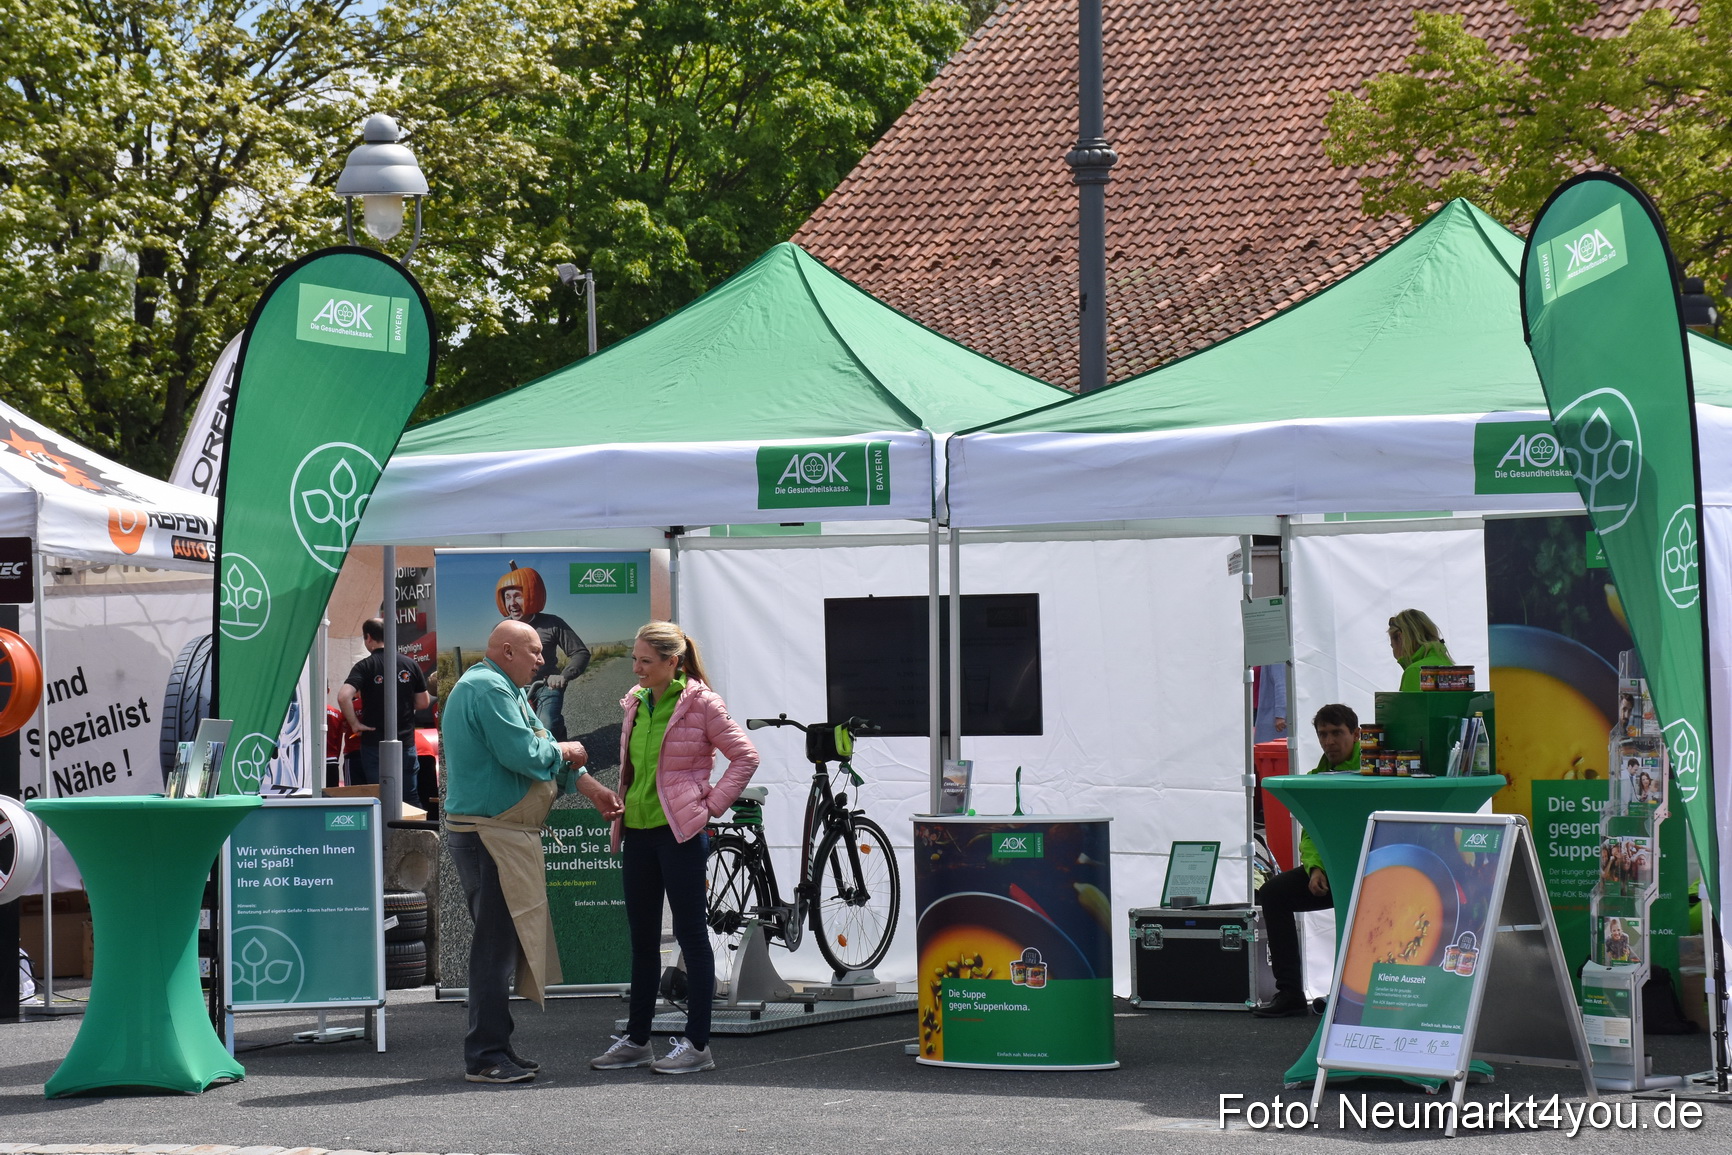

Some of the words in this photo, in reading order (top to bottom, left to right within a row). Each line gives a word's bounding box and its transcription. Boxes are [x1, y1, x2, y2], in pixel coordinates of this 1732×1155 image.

[313, 298, 373, 330] AOK
[394, 307, 404, 341] BAYERN
[310, 322, 320, 331] Die
[320, 324, 374, 339] Gesundheitskasse.
[776, 451, 849, 485] AOK
[874, 449, 884, 491] BAYERN
[1494, 470, 1508, 479] Die
[775, 486, 786, 495] Die
[787, 485, 851, 494] Gesundheitskasse.
[147, 510, 209, 536] REIFEN
[173, 539, 208, 561] AUTO
[0, 562, 24, 576] EC
[579, 568, 616, 583] AOK
[52, 760, 117, 798] Nähe
[1548, 797, 1576, 812] Die
[331, 815, 355, 825] AOK
[1548, 822, 1600, 839] gegen
[999, 837, 1027, 850] AOK
[1465, 833, 1488, 845] AOK
[236, 846, 258, 856] Wir
[260, 845, 319, 856] wünschen
[322, 844, 355, 855] Ihnen
[580, 842, 600, 853] Sie
[603, 841, 625, 853] af
[236, 859, 257, 869] viel
[261, 858, 294, 870] Spaß!
[1561, 868, 1585, 877] Hunger
[237, 877, 260, 888] Ihre
[263, 877, 290, 887] AOK
[293, 877, 334, 889] Bayern
[545, 880, 597, 888] .aok.de/bayern
[1562, 890, 1576, 898] AOK
[1378, 973, 1399, 982] Kleine
[1401, 975, 1426, 984] Auszeit
[948, 989, 960, 998] Die
[962, 989, 987, 1000] Suppe
[948, 1002, 972, 1011] gegen
[973, 1001, 1030, 1013] Suppenkoma.
[1343, 1033, 1385, 1049] HEUTE
[1394, 1037, 1407, 1051] 10
[1427, 1040, 1438, 1053] 16
